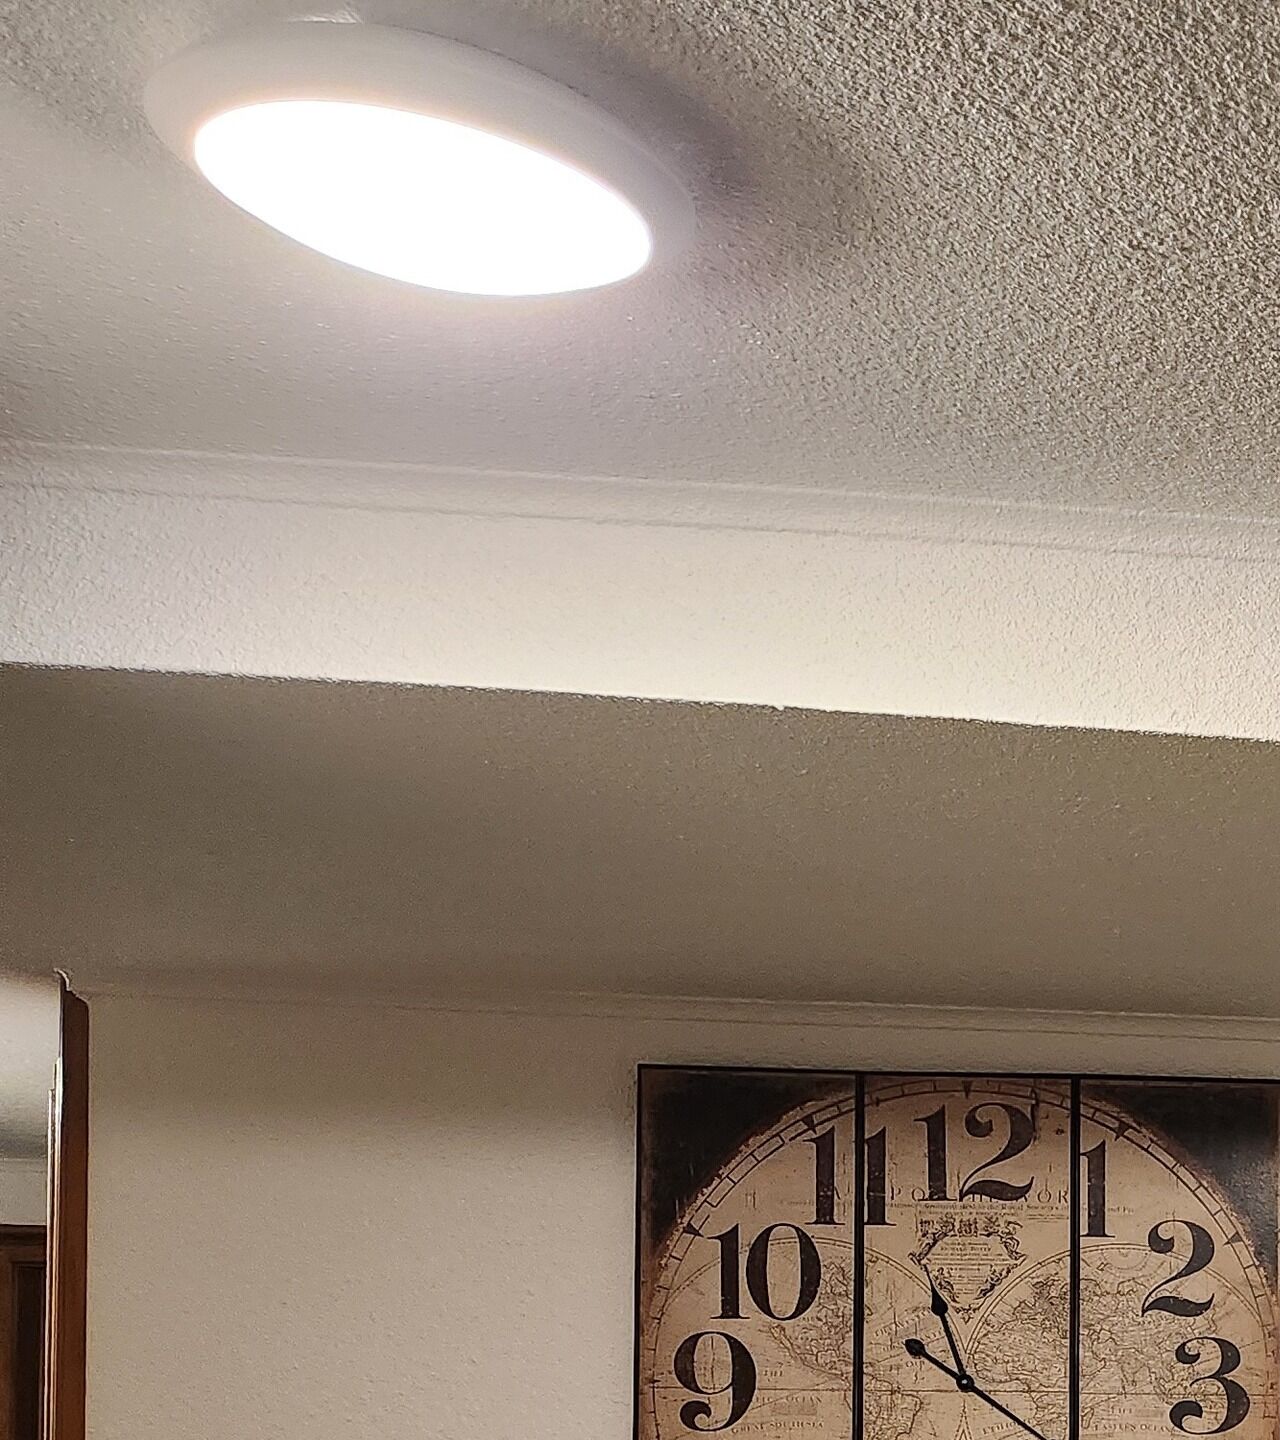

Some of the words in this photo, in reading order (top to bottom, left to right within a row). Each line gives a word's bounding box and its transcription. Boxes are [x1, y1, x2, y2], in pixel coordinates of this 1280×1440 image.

[803, 1125, 898, 1227] 11
[914, 1103, 1036, 1202] 12
[1079, 1140, 1115, 1238] 1
[706, 1221, 822, 1321] 10
[1142, 1220, 1216, 1318] 2
[673, 1331, 757, 1432] 9
[1169, 1336, 1251, 1435] 3
